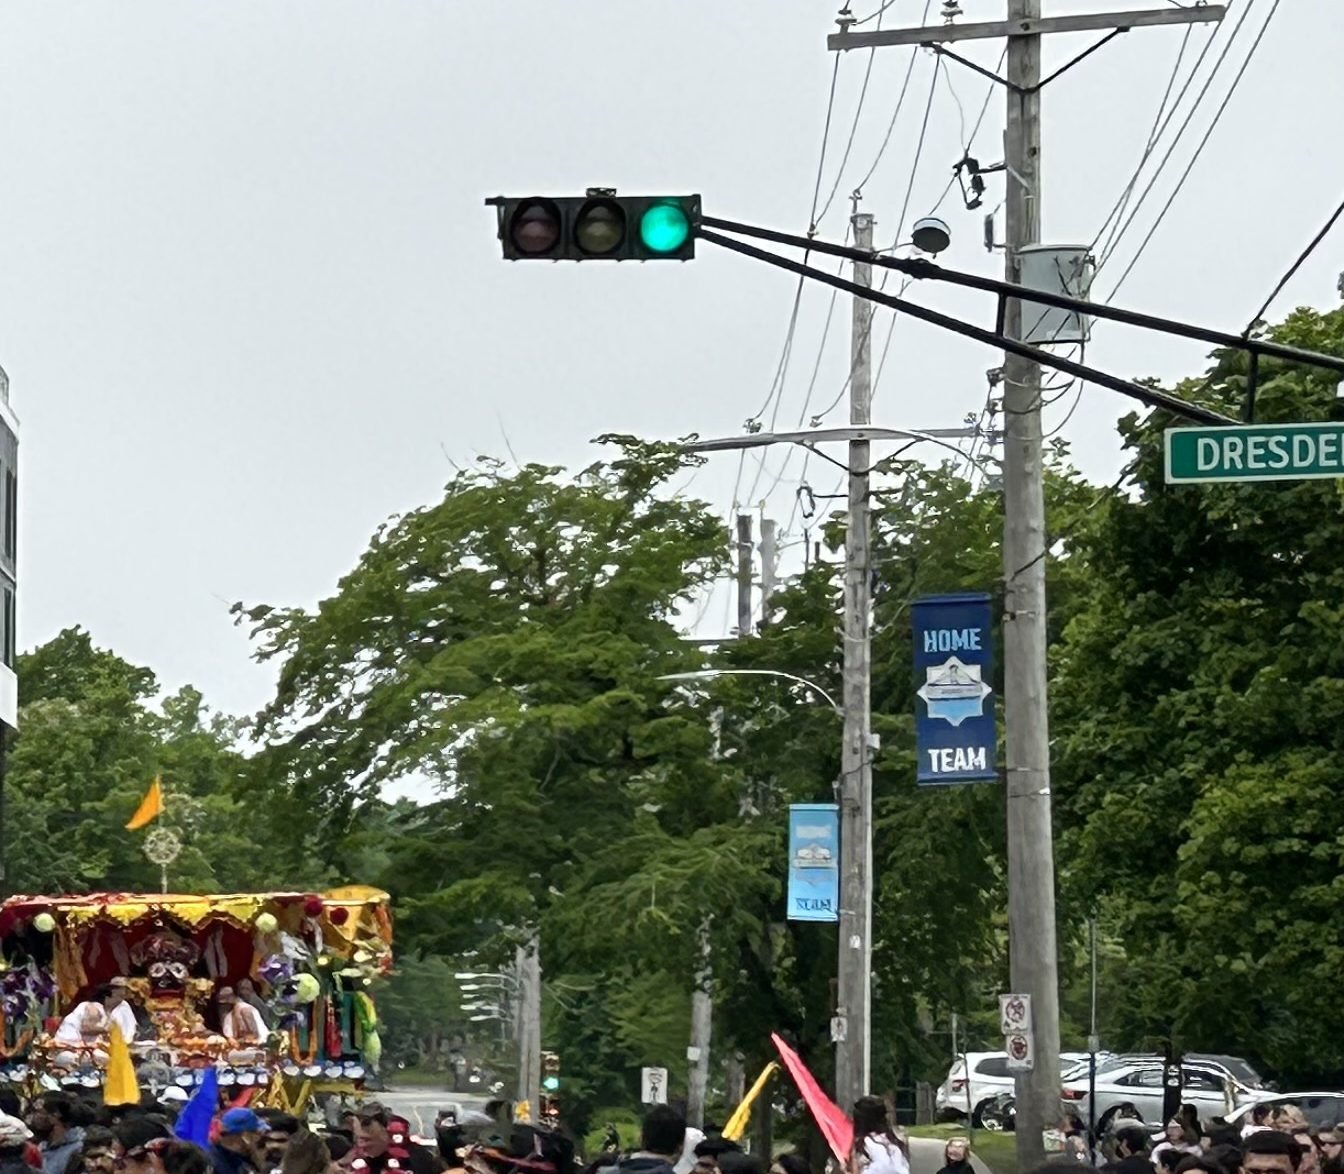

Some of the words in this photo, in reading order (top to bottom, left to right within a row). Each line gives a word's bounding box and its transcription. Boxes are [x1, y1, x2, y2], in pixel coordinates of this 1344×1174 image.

[1197, 433, 1344, 471] DRESDE
[924, 628, 982, 653] HOME
[928, 747, 987, 773] TEAM
